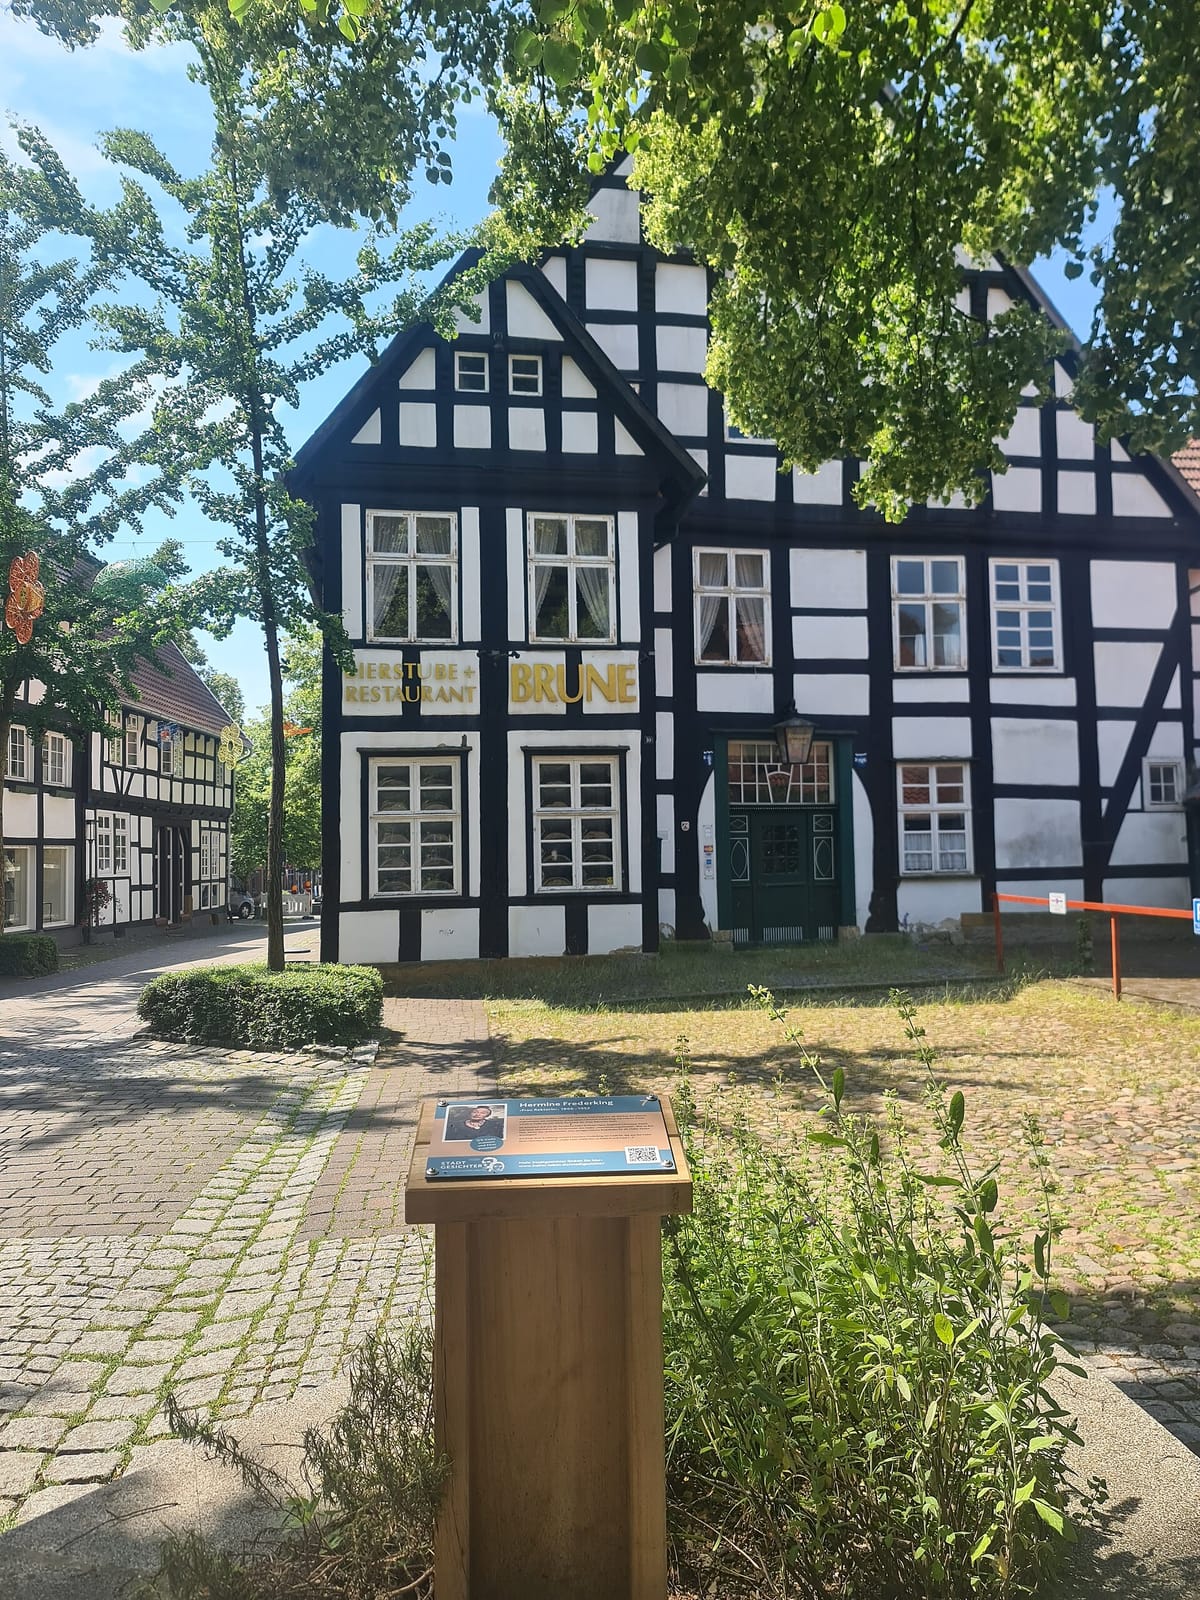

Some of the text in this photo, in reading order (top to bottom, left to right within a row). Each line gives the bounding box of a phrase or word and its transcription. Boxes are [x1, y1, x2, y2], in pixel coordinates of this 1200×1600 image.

[344, 662, 458, 681] IERSTUBE
[510, 663, 637, 704] BRUNE
[345, 685, 477, 704] RESTAURANT
[519, 1099, 614, 1109] Hermine Frederking
